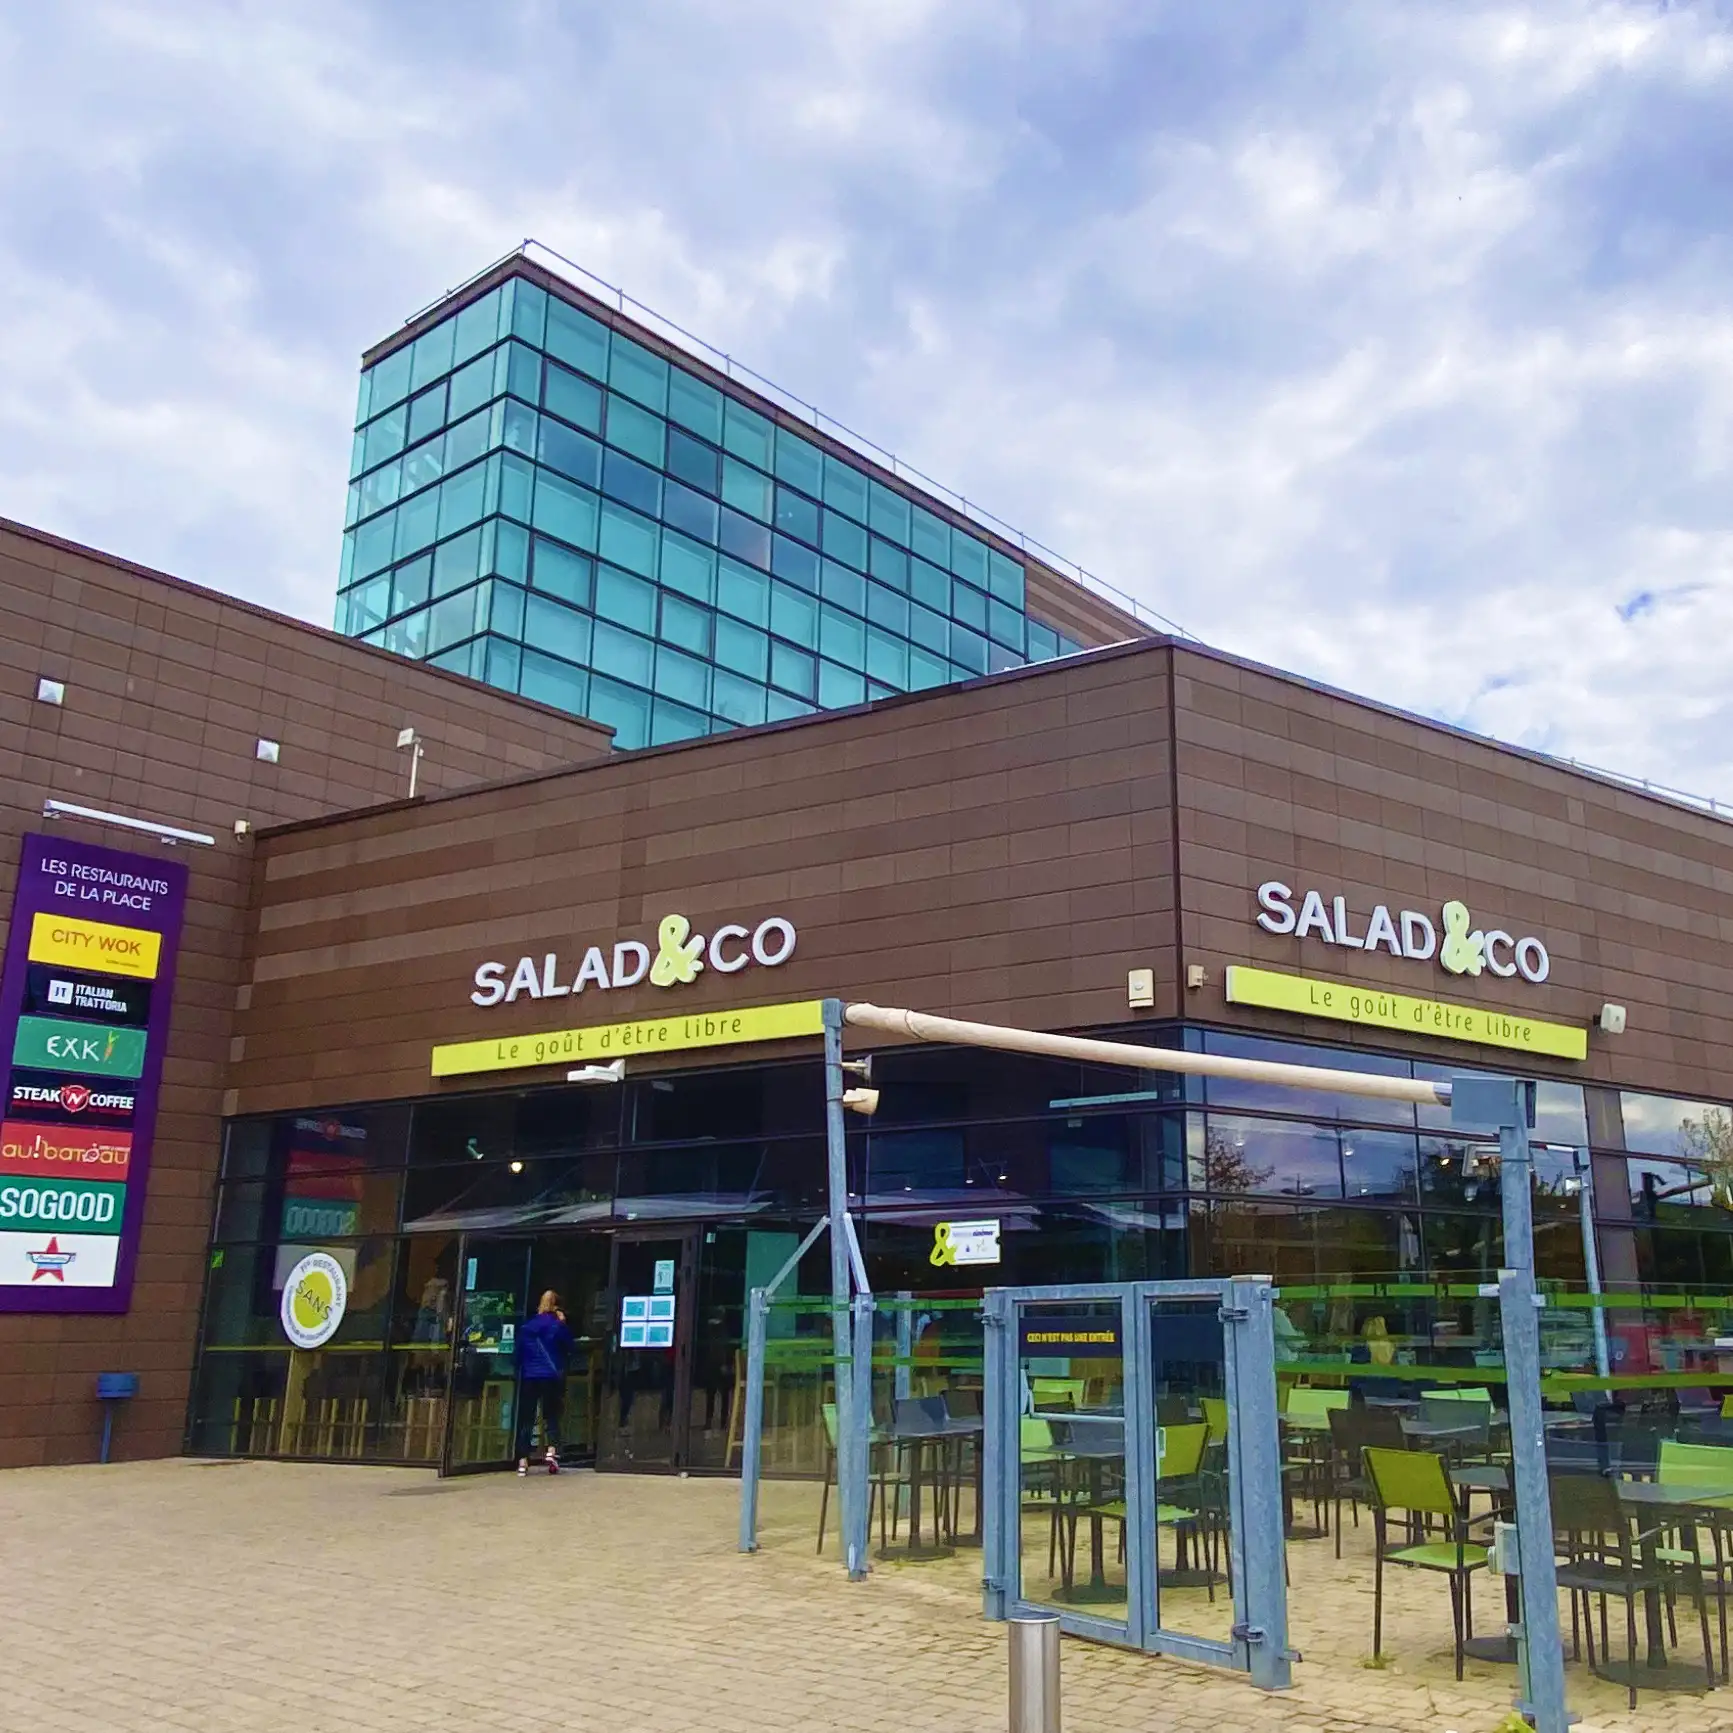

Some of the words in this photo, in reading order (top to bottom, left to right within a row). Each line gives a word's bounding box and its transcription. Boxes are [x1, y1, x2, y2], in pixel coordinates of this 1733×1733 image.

[41, 858, 67, 875] LES
[71, 863, 168, 895] RESTAURANTS
[55, 880, 77, 897] DE
[80, 885, 99, 901] LA
[103, 889, 152, 911] PLACE
[52, 929, 94, 948] CITY
[99, 936, 142, 956] WOK
[75, 996, 128, 1012] TRATTORIA
[76, 984, 114, 999] ITALIAN
[1310, 985, 1332, 1007] Le
[1351, 995, 1398, 1020] goût
[1414, 1003, 1472, 1032] d'être
[1486, 1018, 1531, 1042] libre
[498, 1041, 519, 1060] Le
[535, 1033, 583, 1062] goût
[600, 1025, 667, 1049] d'être
[685, 1015, 742, 1039] libre
[13, 1086, 61, 1103] STEAK
[89, 1093, 135, 1110] COFFEE
[0, 1187, 115, 1223] SOGOOD
[296, 1280, 333, 1320] SANS
